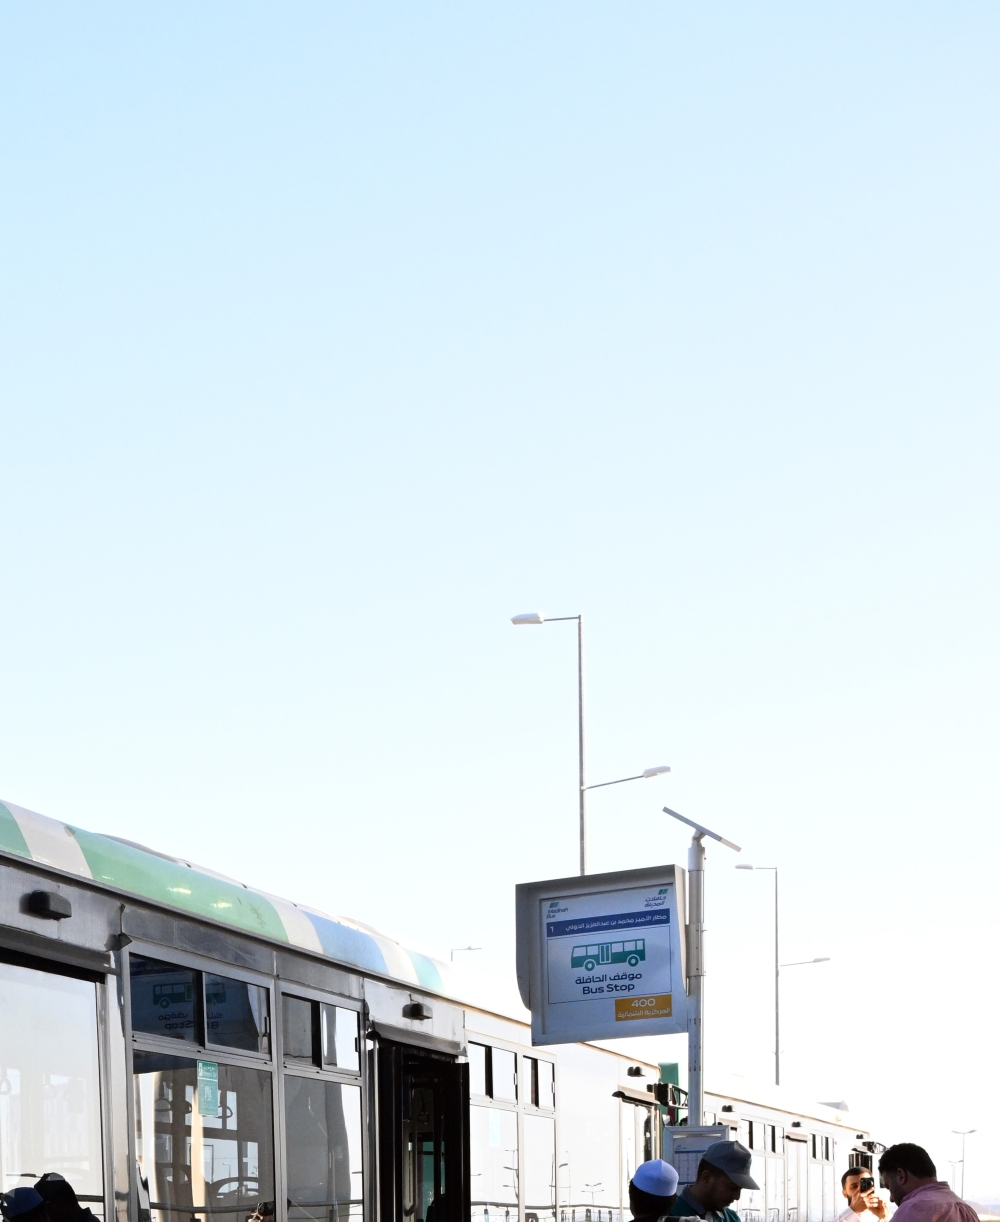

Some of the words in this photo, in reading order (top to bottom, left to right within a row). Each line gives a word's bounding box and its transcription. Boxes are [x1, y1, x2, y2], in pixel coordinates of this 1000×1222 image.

[575, 974, 607, 985] الحافلة
[609, 972, 643, 981] موقف
[582, 986, 604, 995] Bus
[606, 983, 635, 992] Stop
[631, 998, 656, 1008] 400
